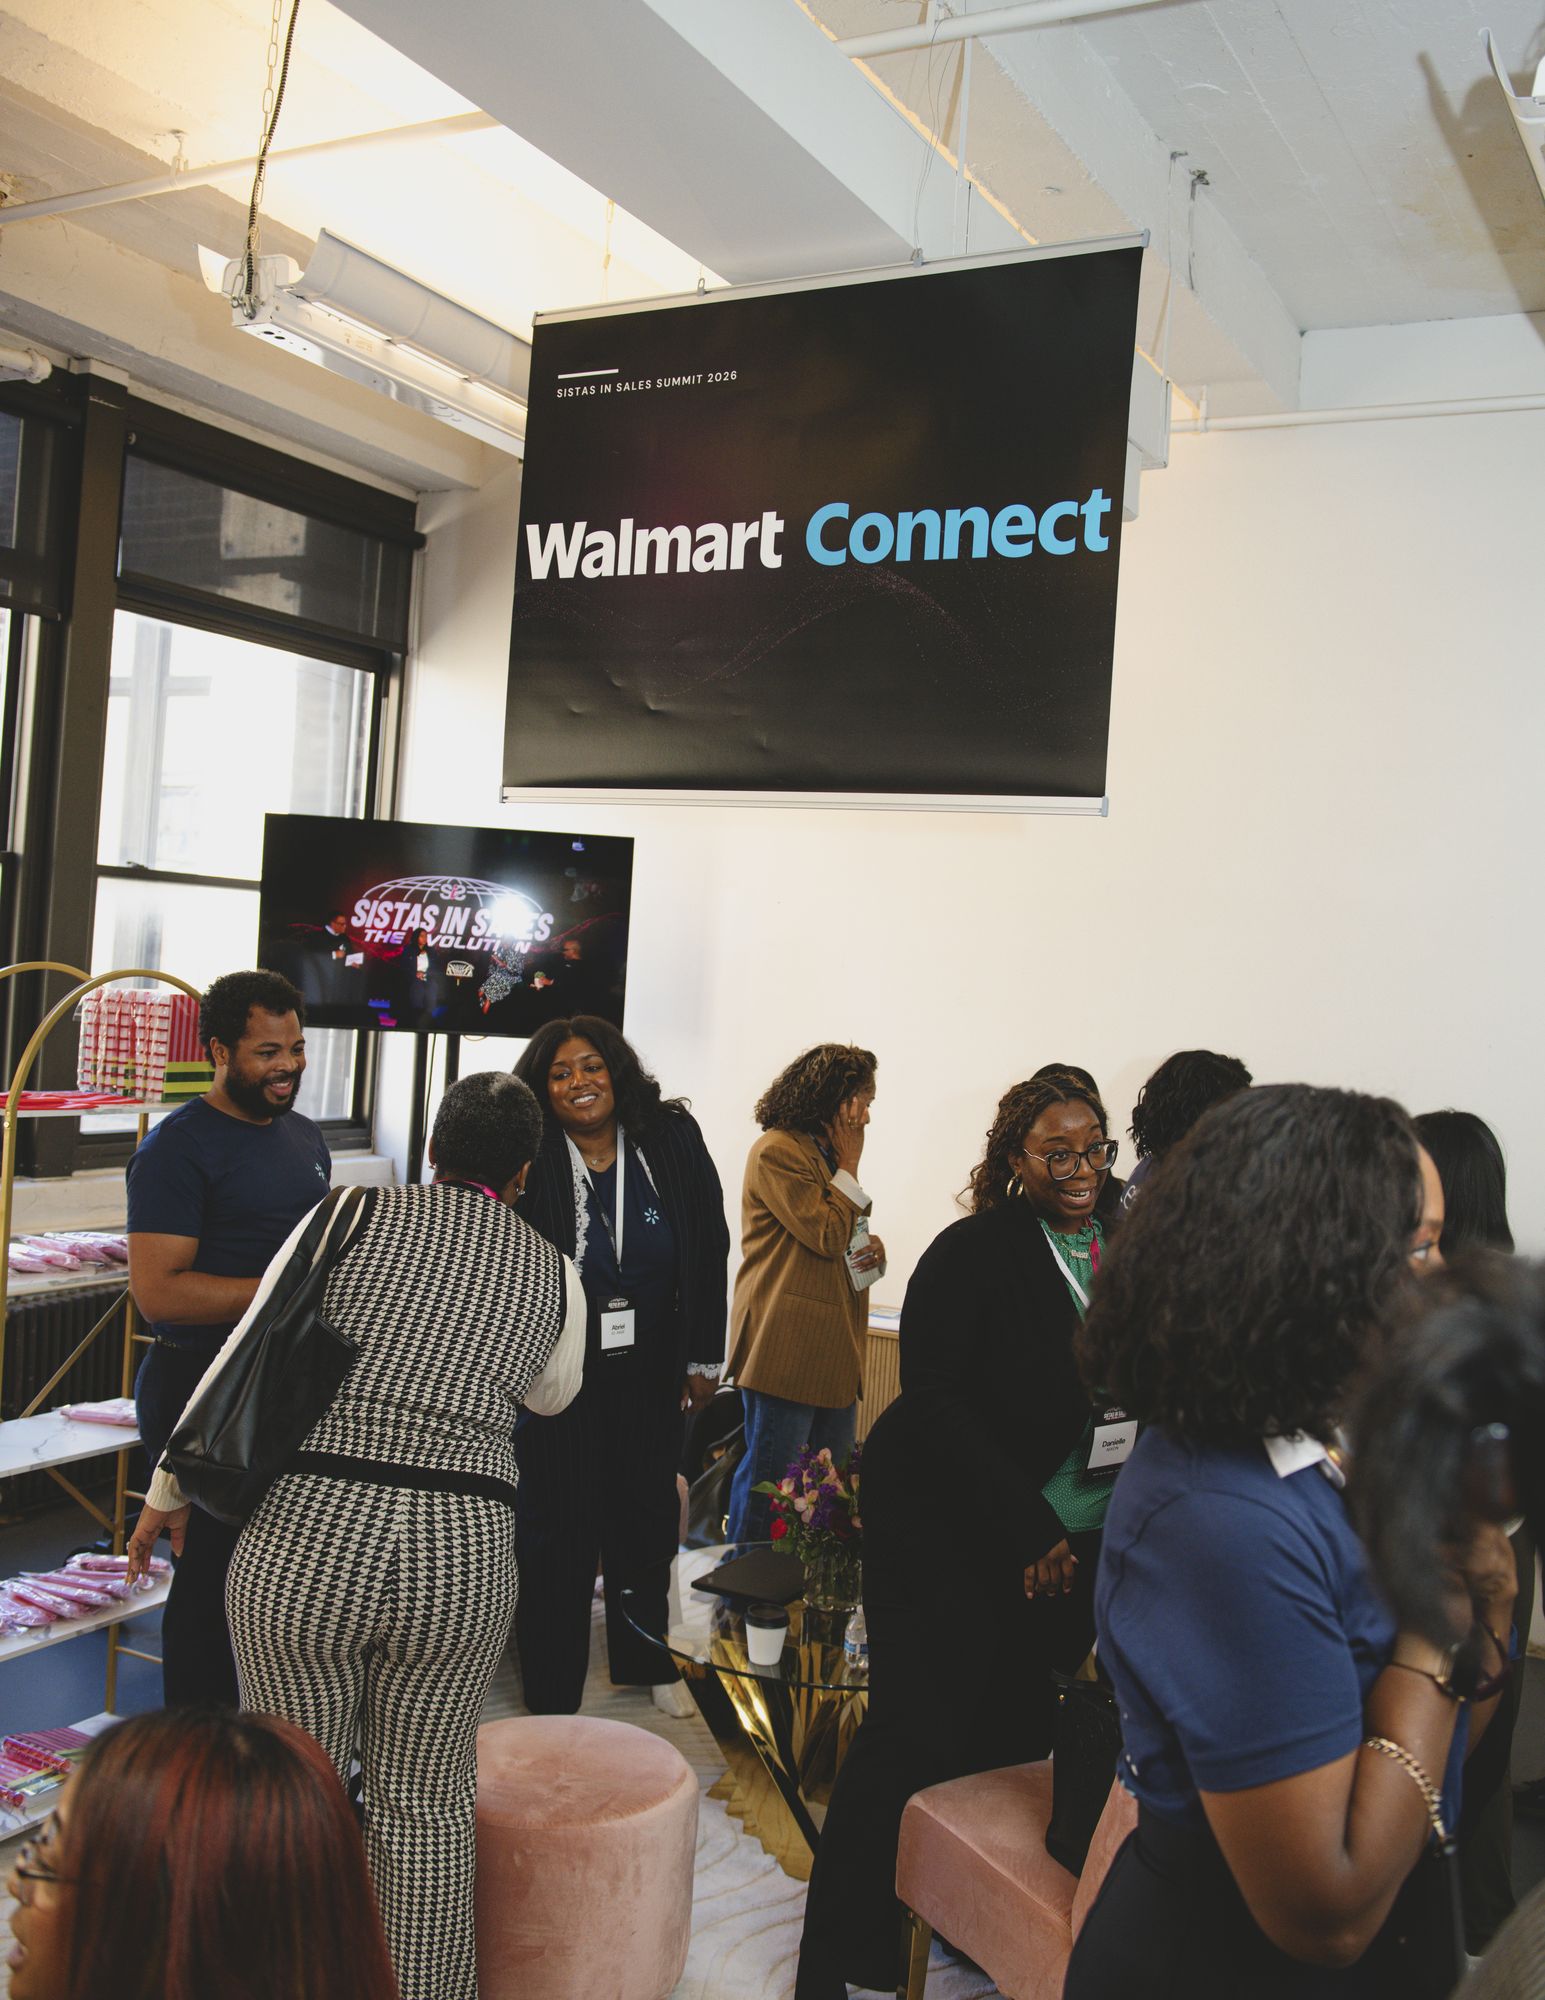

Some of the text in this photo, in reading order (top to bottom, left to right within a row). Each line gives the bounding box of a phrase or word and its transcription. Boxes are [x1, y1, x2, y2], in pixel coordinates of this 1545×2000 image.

[556, 370, 737, 398] SISTAS IN SALES SUMMIT 2026
[525, 488, 1112, 580] Walmart Connect
[351, 899, 440, 933] SISTAS
[440, 906, 471, 936] IN
[364, 929, 407, 945] THE
[1102, 1437, 1126, 1448] Danielle
